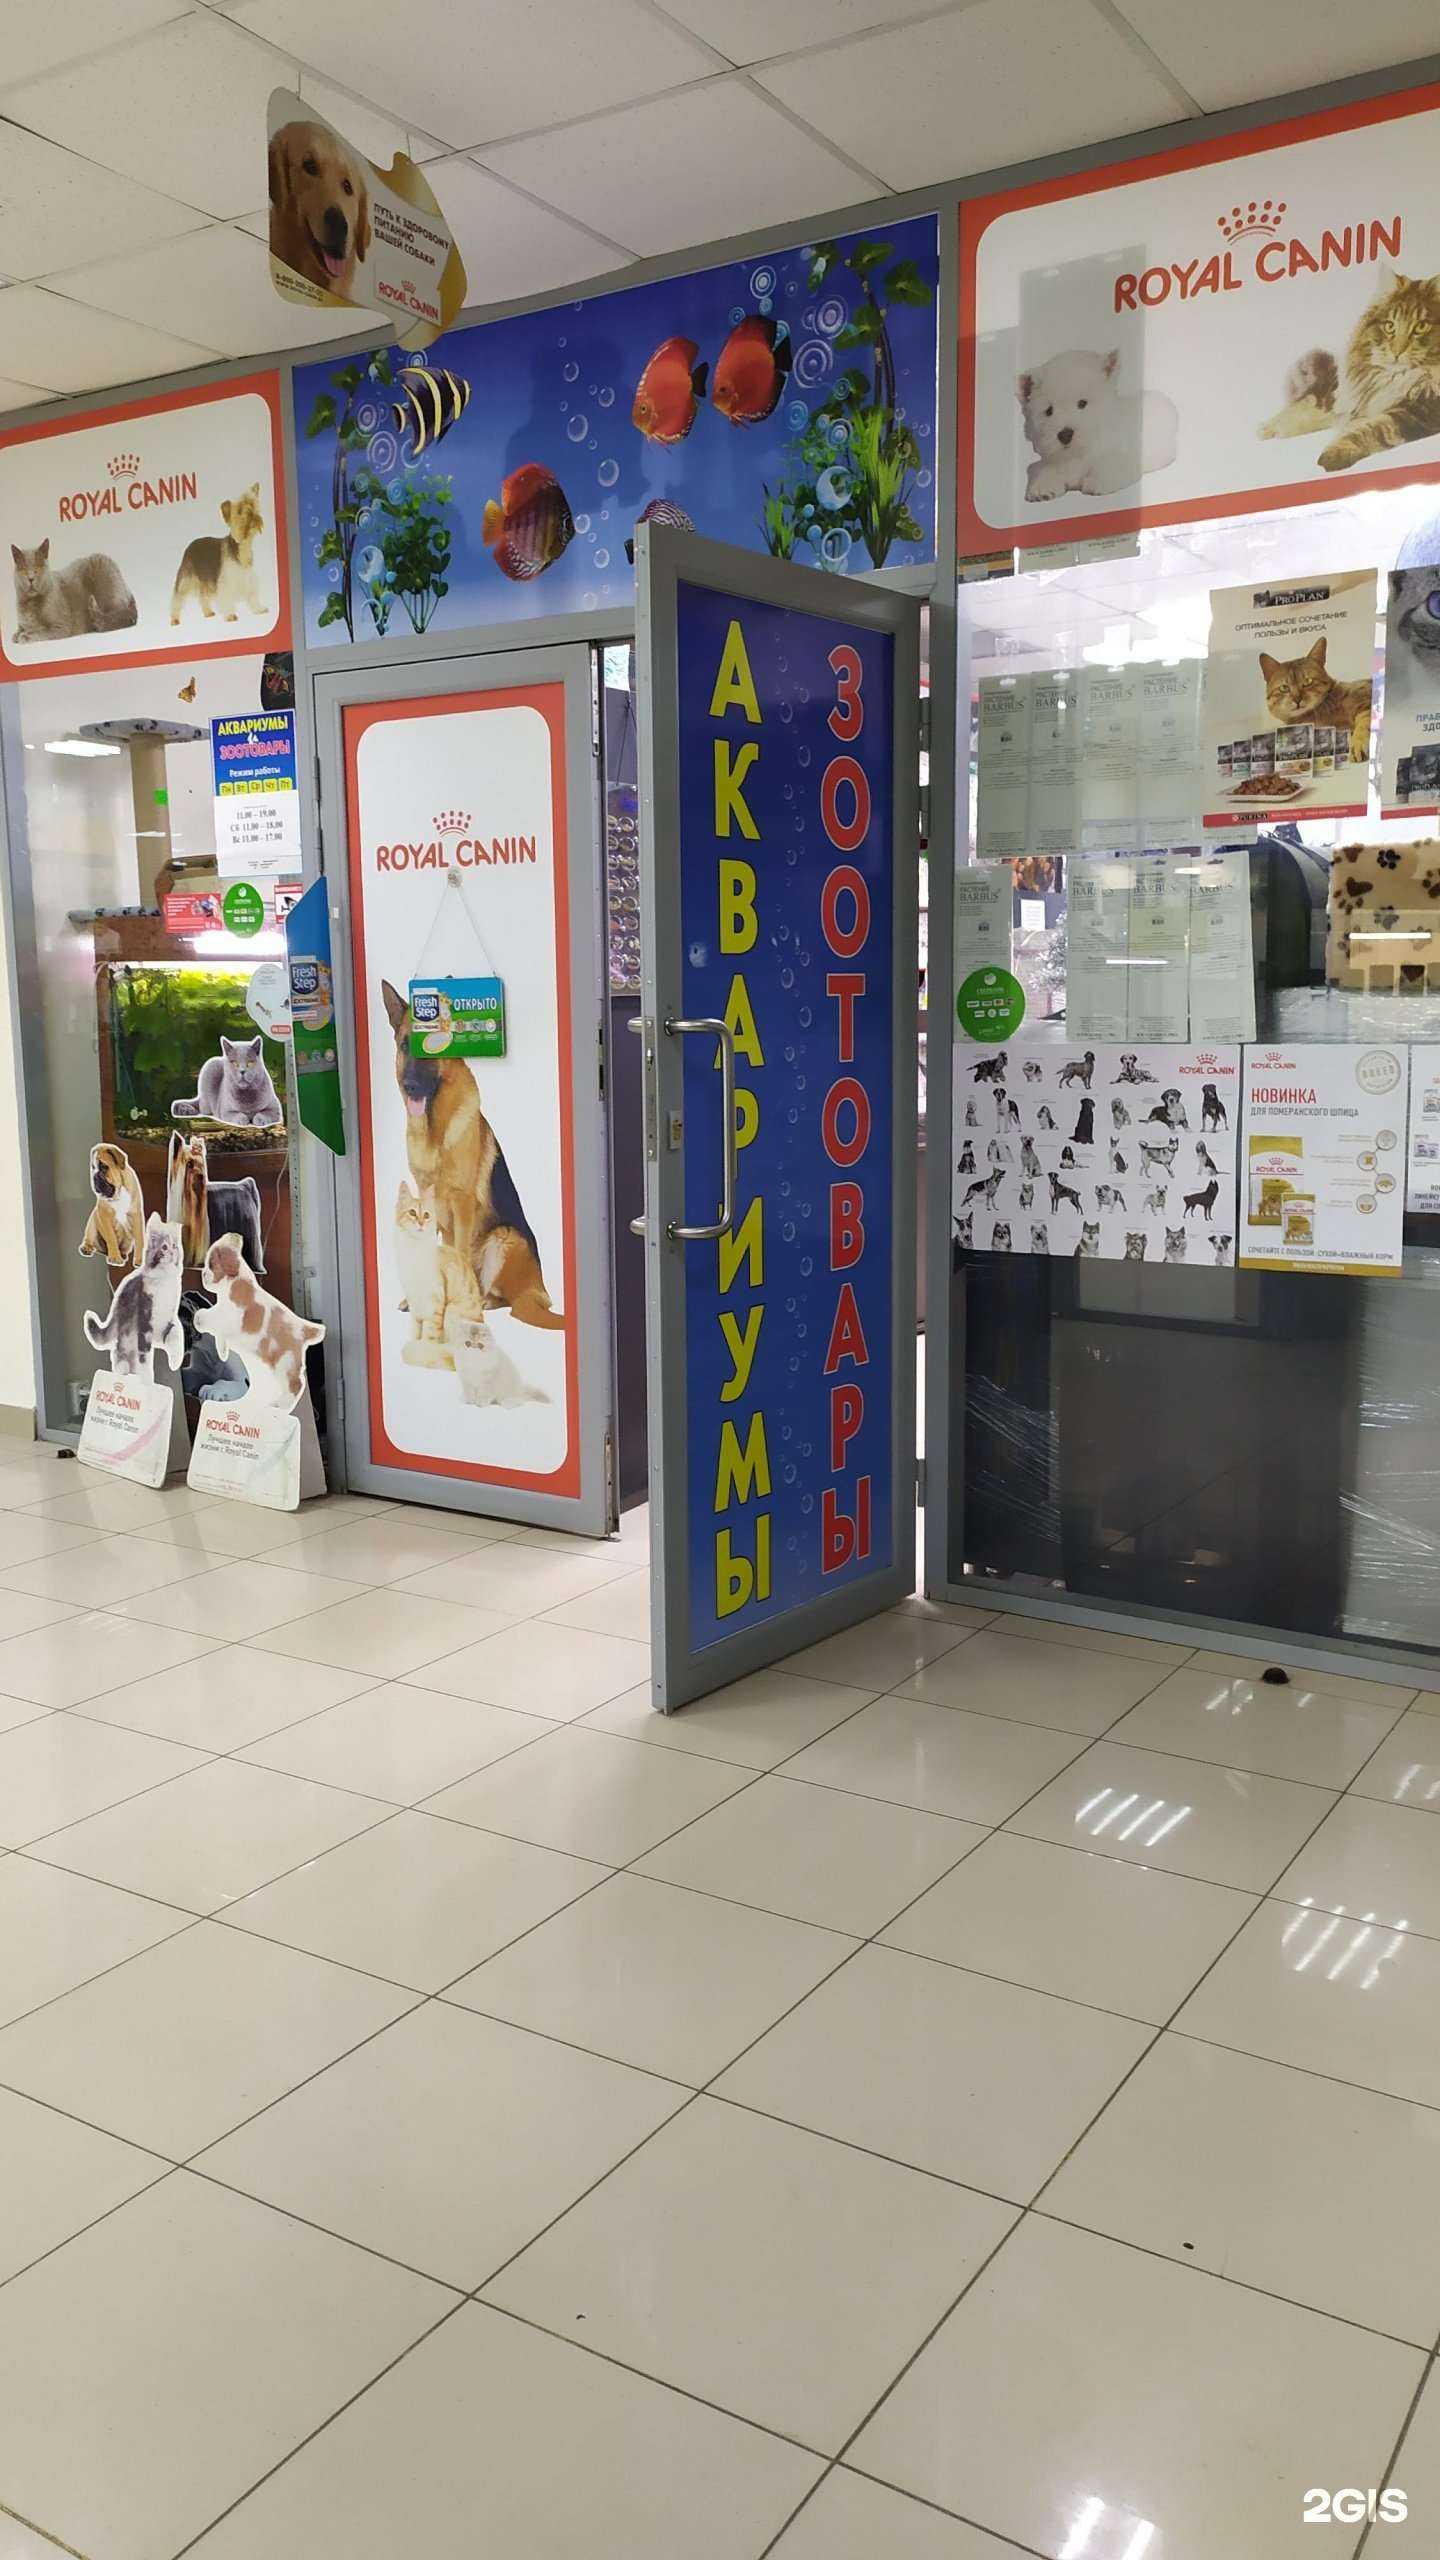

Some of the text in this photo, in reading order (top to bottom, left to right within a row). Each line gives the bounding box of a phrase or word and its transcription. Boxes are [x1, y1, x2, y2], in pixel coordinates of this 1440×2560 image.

[374, 203, 450, 249] ПУТЬ К ЗДОРОВОМУ
[374, 215, 415, 243] ПИТАНИЮ
[374, 228, 436, 267] ВАШЕЙ СОБАКИ
[1114, 215, 1402, 314] ROYAL CANIN
[378, 281, 439, 320] ROYAL CANIN
[59, 471, 197, 522] ROYAL CANIN
[1235, 610, 1348, 631] ОПТИМАЛЬНОЕ СОЧЕТАНИЕ
[1254, 627, 1290, 639] ПОЛЬЗЫ
[1299, 623, 1327, 634] ВКУСА
[218, 715, 289, 736] АКВАРИУМЫ
[219, 739, 290, 760] ЗООТОВАРЫ
[229, 766, 281, 778] Режим работы
[377, 836, 537, 872] ROYAL CANIN
[292, 966, 317, 978] Fresh
[294, 978, 317, 990] Step
[414, 996, 438, 1008] Fresh
[453, 998, 497, 1011] ОТКРЫТО
[415, 1007, 437, 1019] Step
[1179, 1066, 1235, 1075] ROYAL CANIN
[1251, 1062, 1296, 1070] ROYAL CANIN
[1251, 1088, 1317, 1103] НОВИНКА
[709, 619, 774, 1621] АКВАРИУМЫ
[820, 644, 872, 1576] ЗООТОВАРЫ
[1250, 1106, 1359, 1118] ДЛЯ ПОМЕРАНСКОГО ШПИЦА
[95, 1390, 140, 1411] ROYAL CANIN
[207, 1419, 261, 1438] ROYAL CANIN
